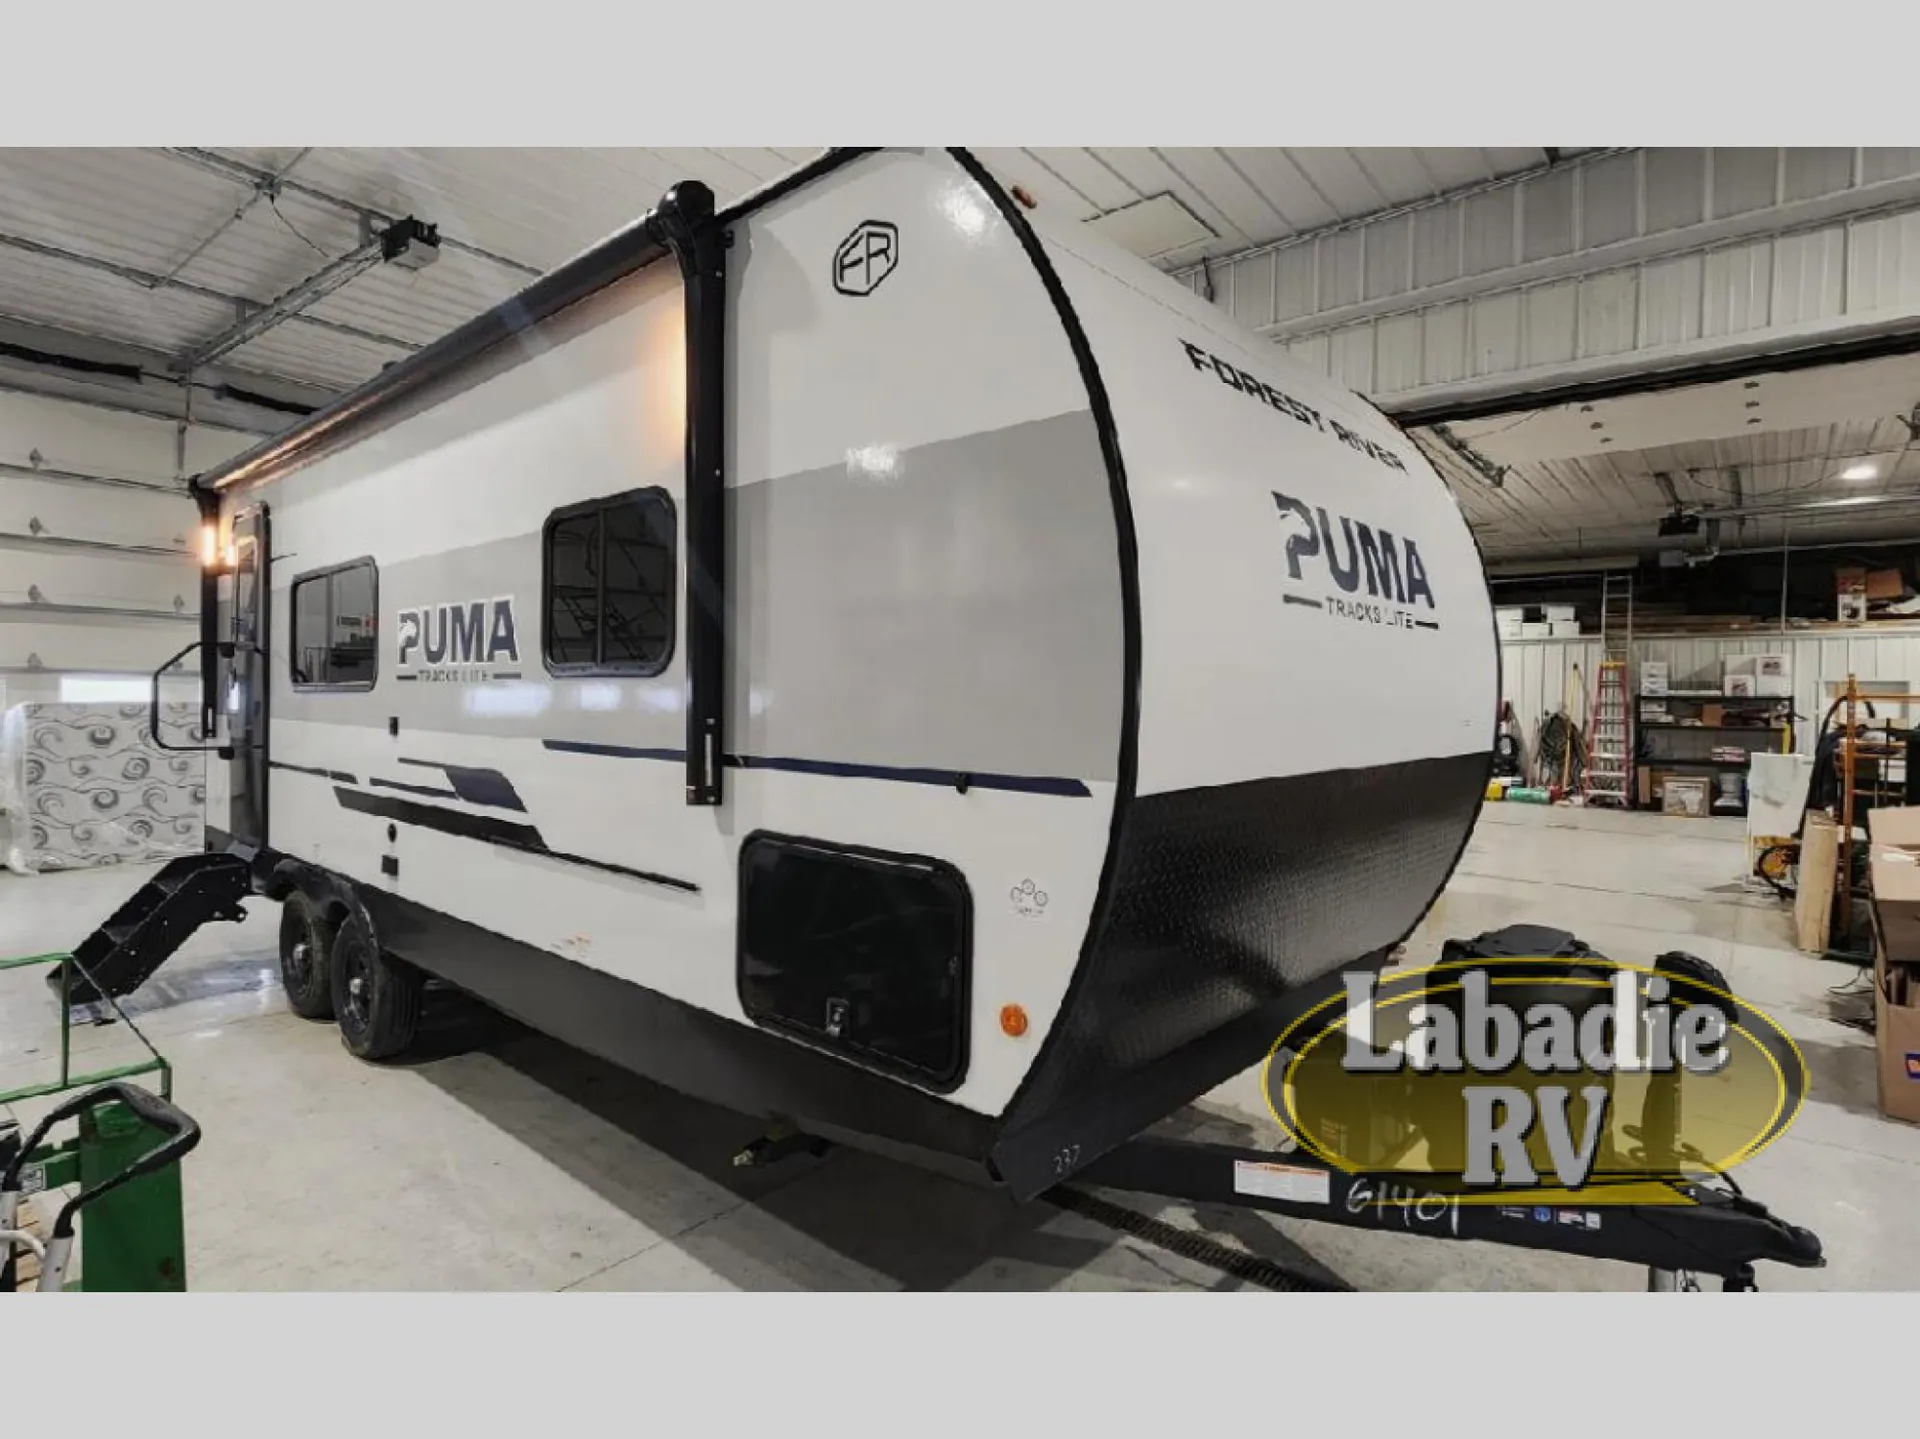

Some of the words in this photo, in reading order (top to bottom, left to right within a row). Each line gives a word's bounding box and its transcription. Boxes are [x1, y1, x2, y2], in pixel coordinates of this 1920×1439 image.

[1177, 337, 1325, 432] FOREST
[1329, 419, 1409, 475] RIVER
[1271, 490, 1435, 609] PUMA
[398, 598, 519, 665] PUMA
[1326, 597, 1381, 624] TRACKS
[418, 669, 459, 682] TRACKS
[1346, 1177, 1460, 1236] 61401
